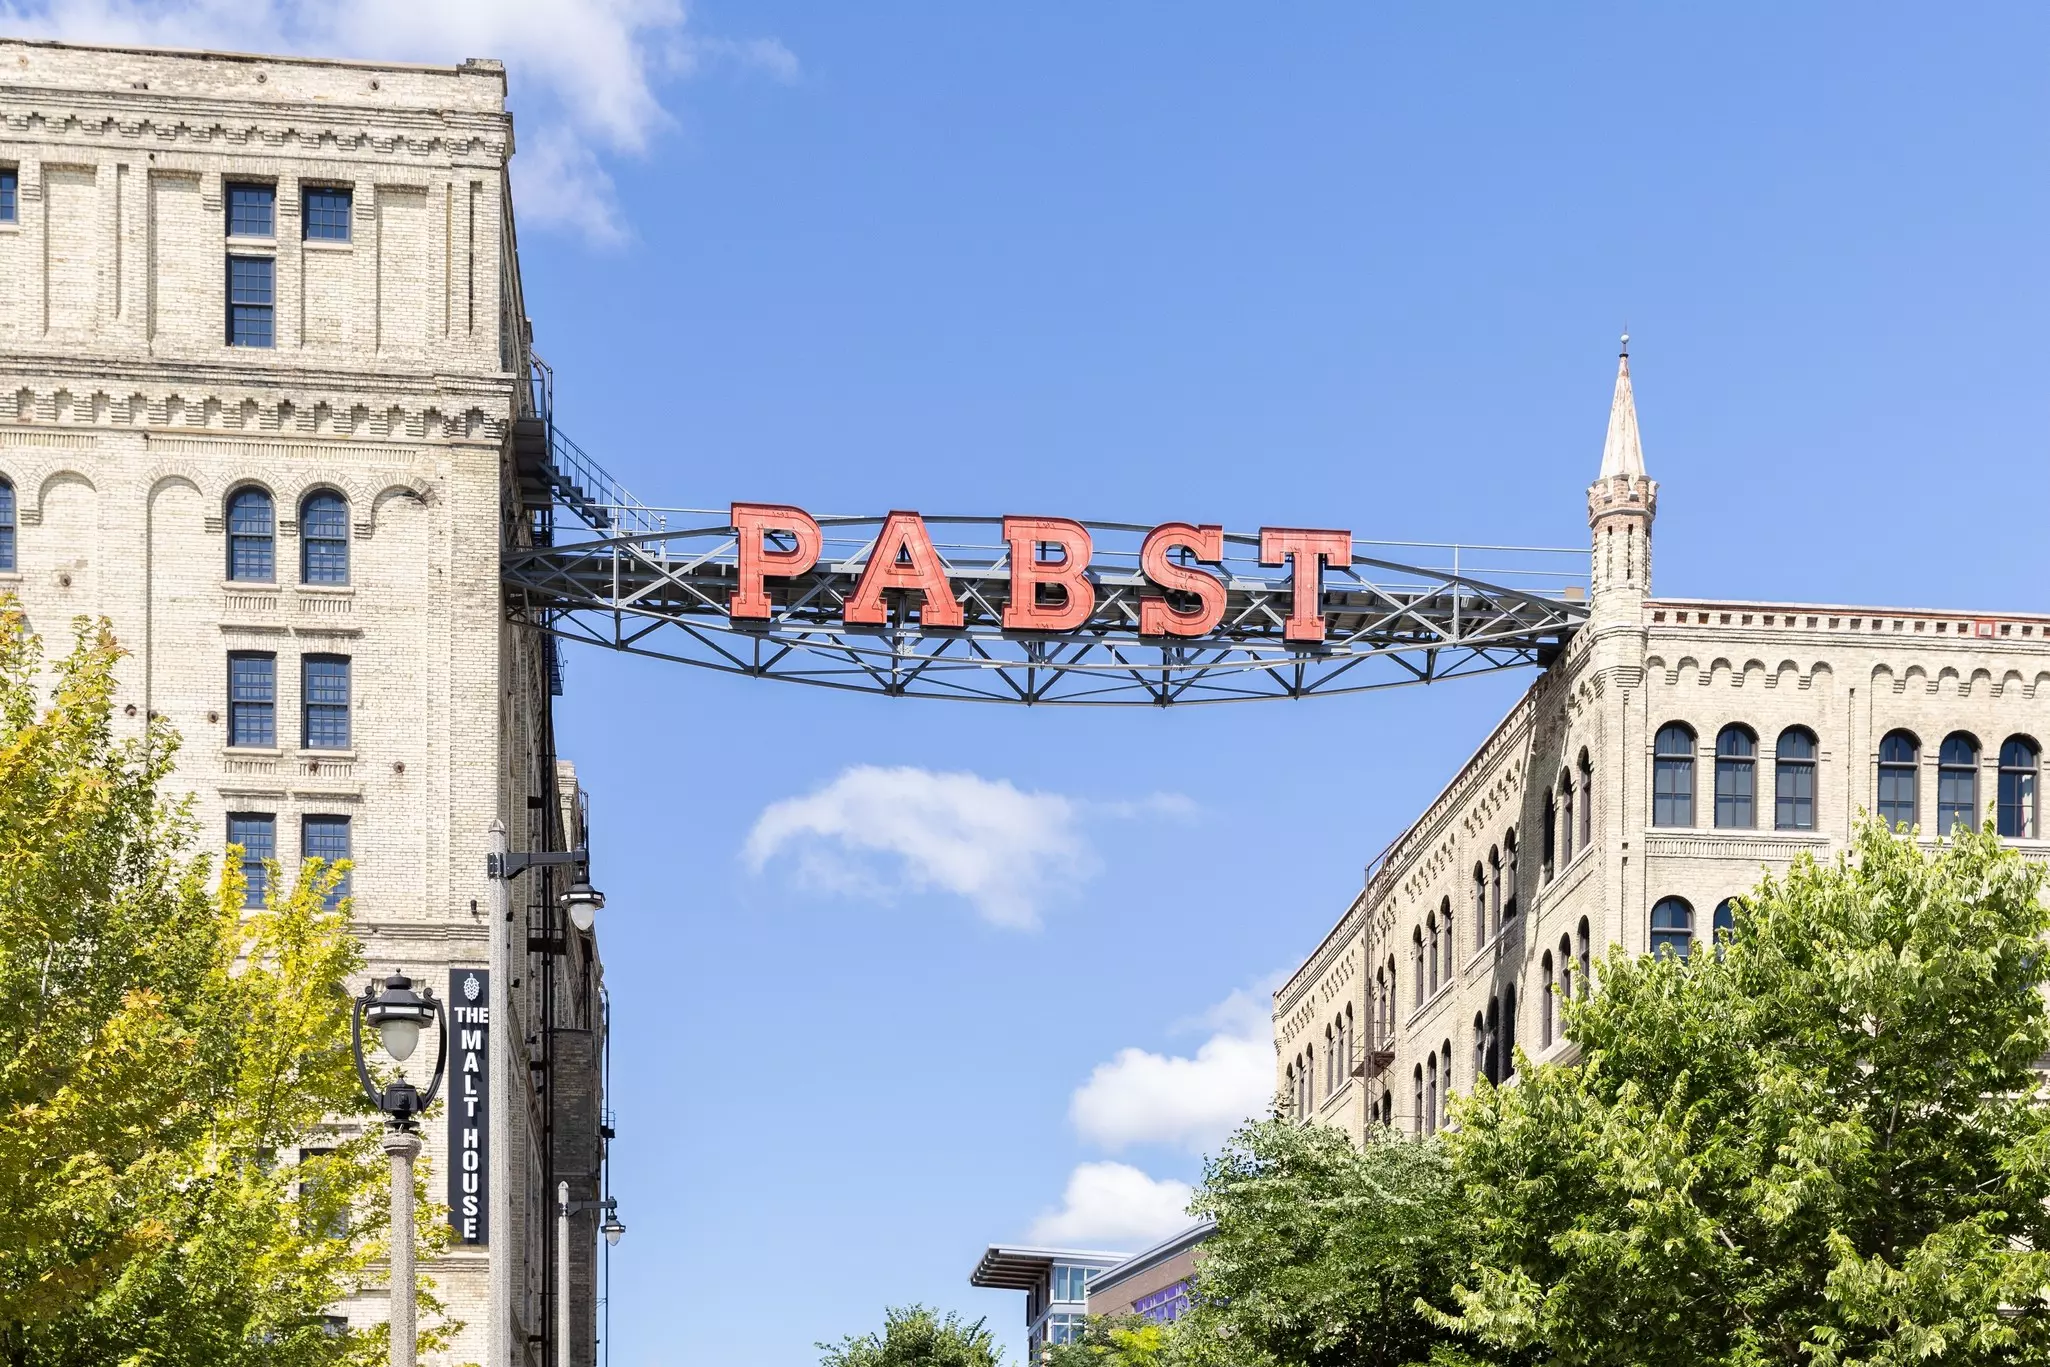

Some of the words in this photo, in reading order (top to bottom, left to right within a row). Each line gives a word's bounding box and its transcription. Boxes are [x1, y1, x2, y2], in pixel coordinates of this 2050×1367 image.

[730, 502, 1352, 642] PABST
[453, 1006, 489, 1023] THE
[461, 1029, 482, 1118] MALT
[462, 1128, 479, 1239] HOUSE
